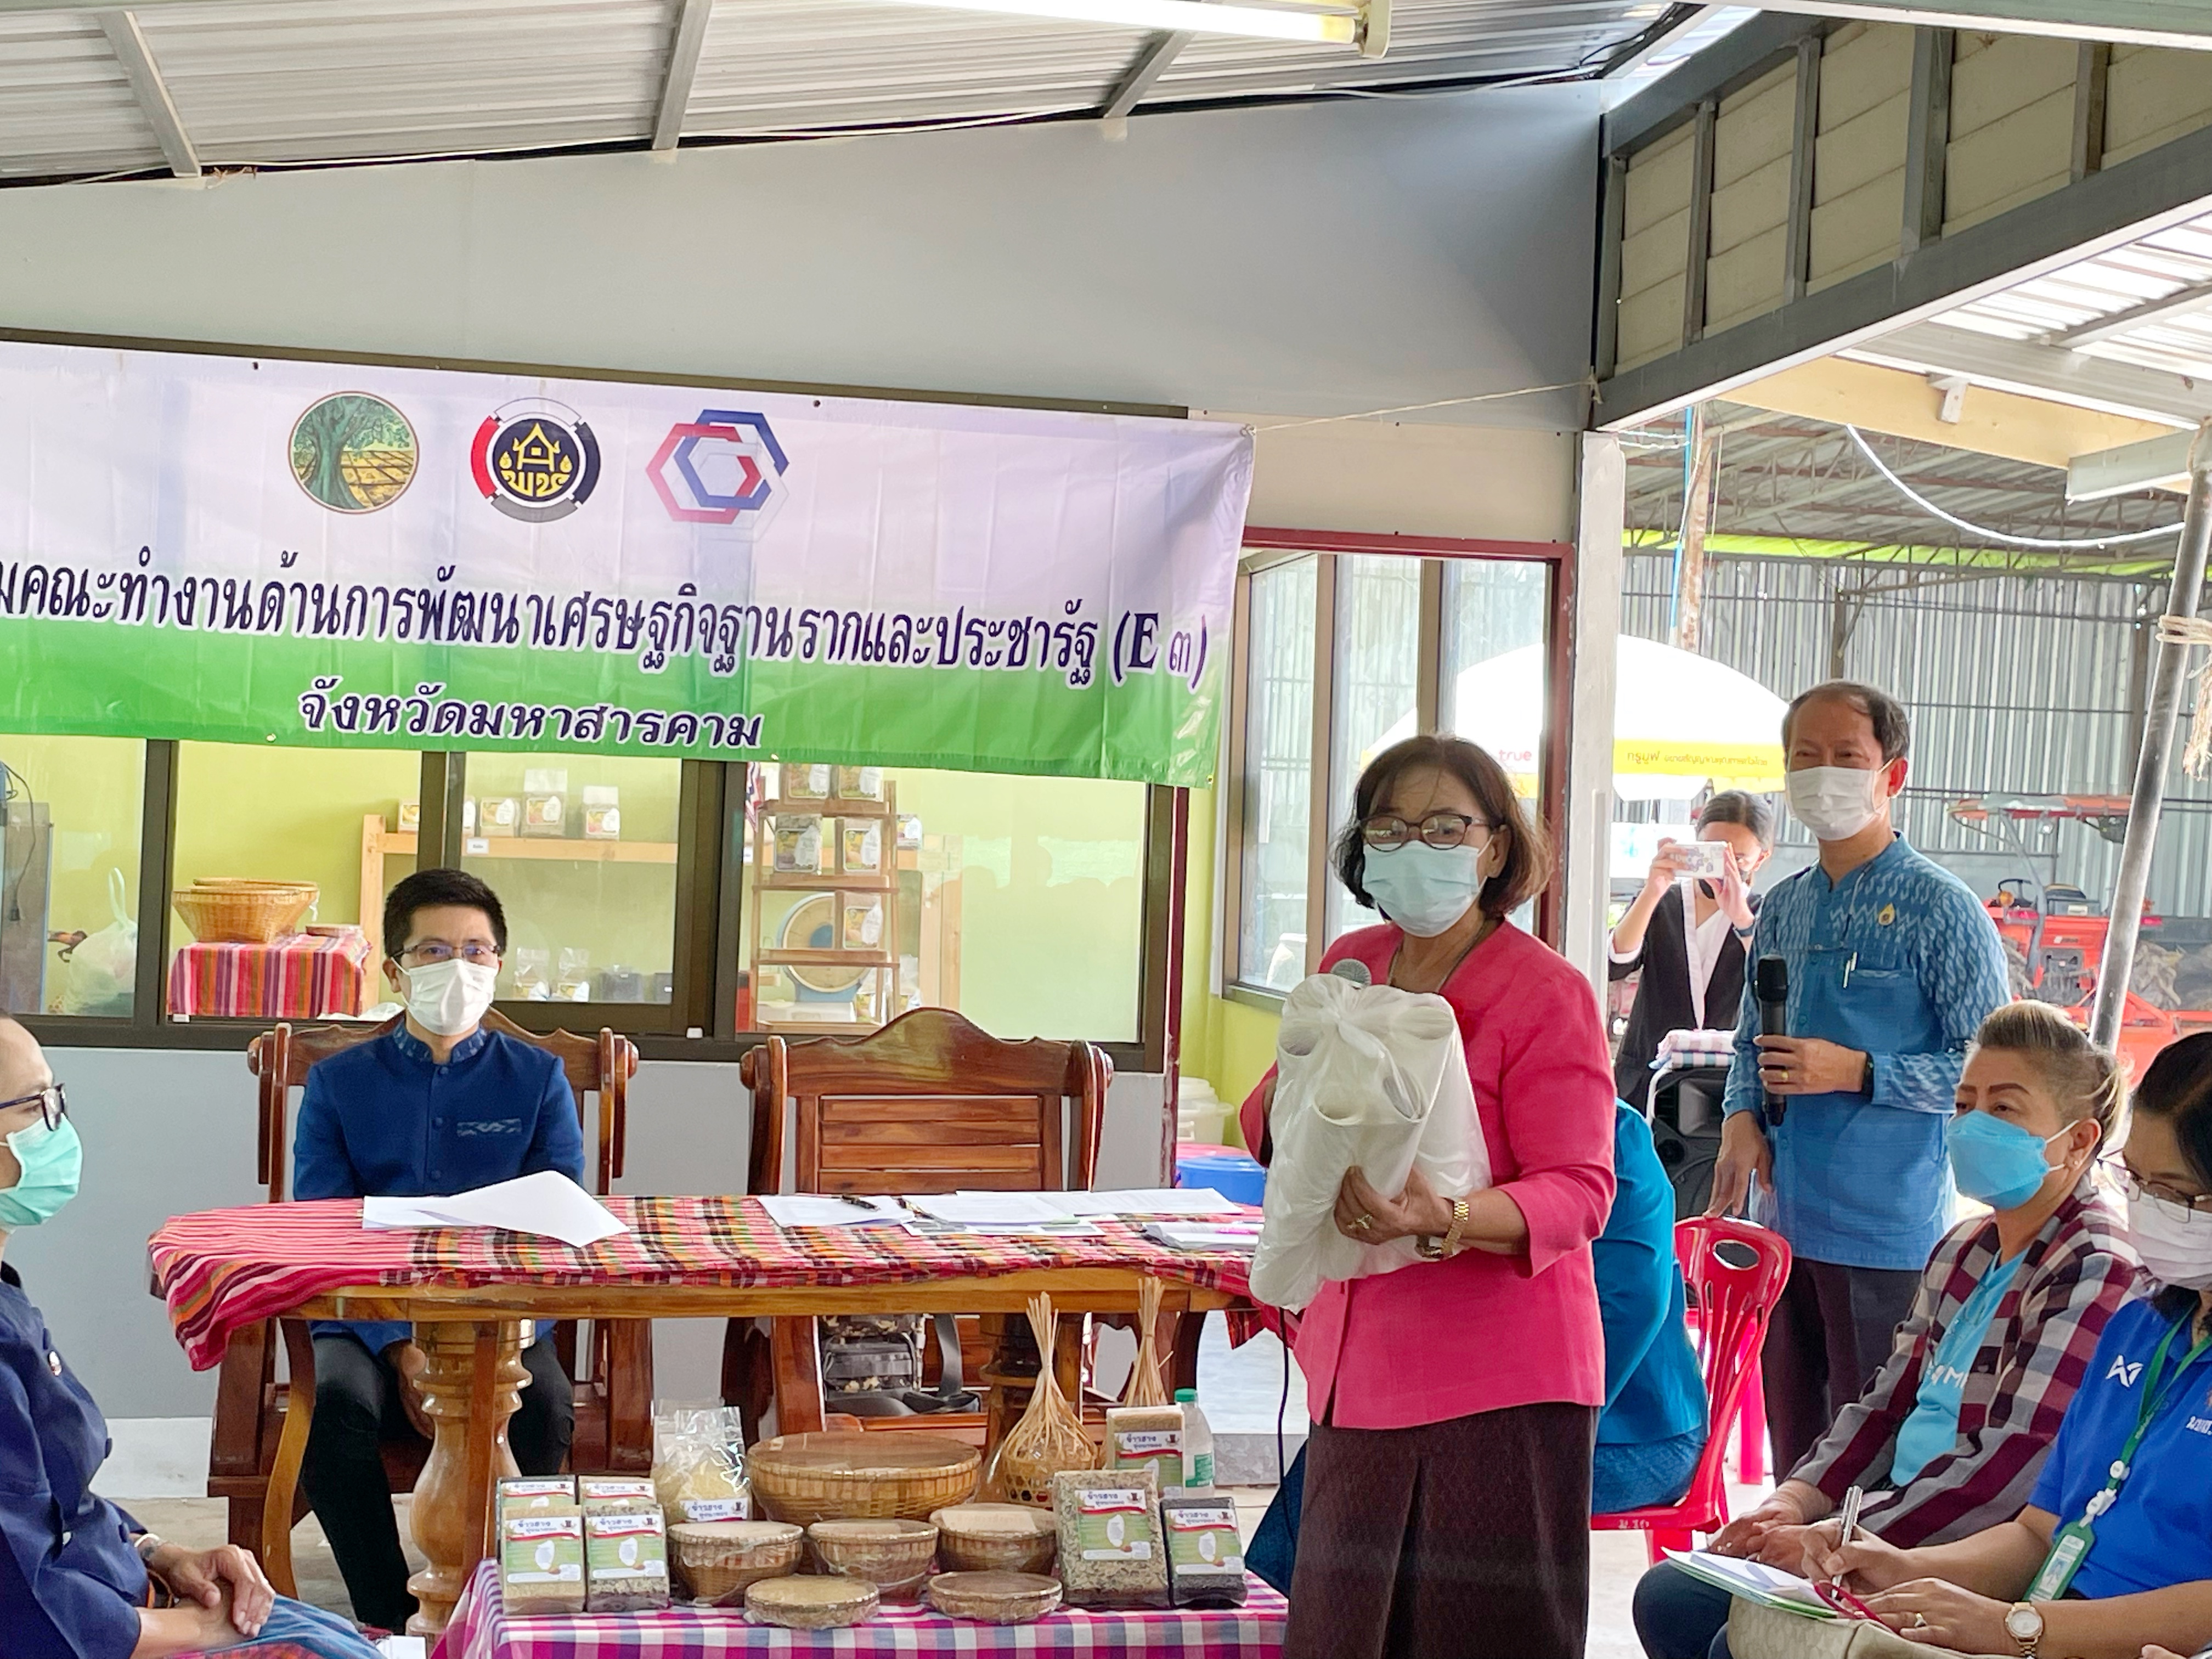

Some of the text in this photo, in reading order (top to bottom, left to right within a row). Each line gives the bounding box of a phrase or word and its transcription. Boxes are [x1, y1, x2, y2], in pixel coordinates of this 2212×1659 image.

[301, 678, 761, 747] จังหวัดมหาสารคาม
[1498, 749, 1532, 761] true
